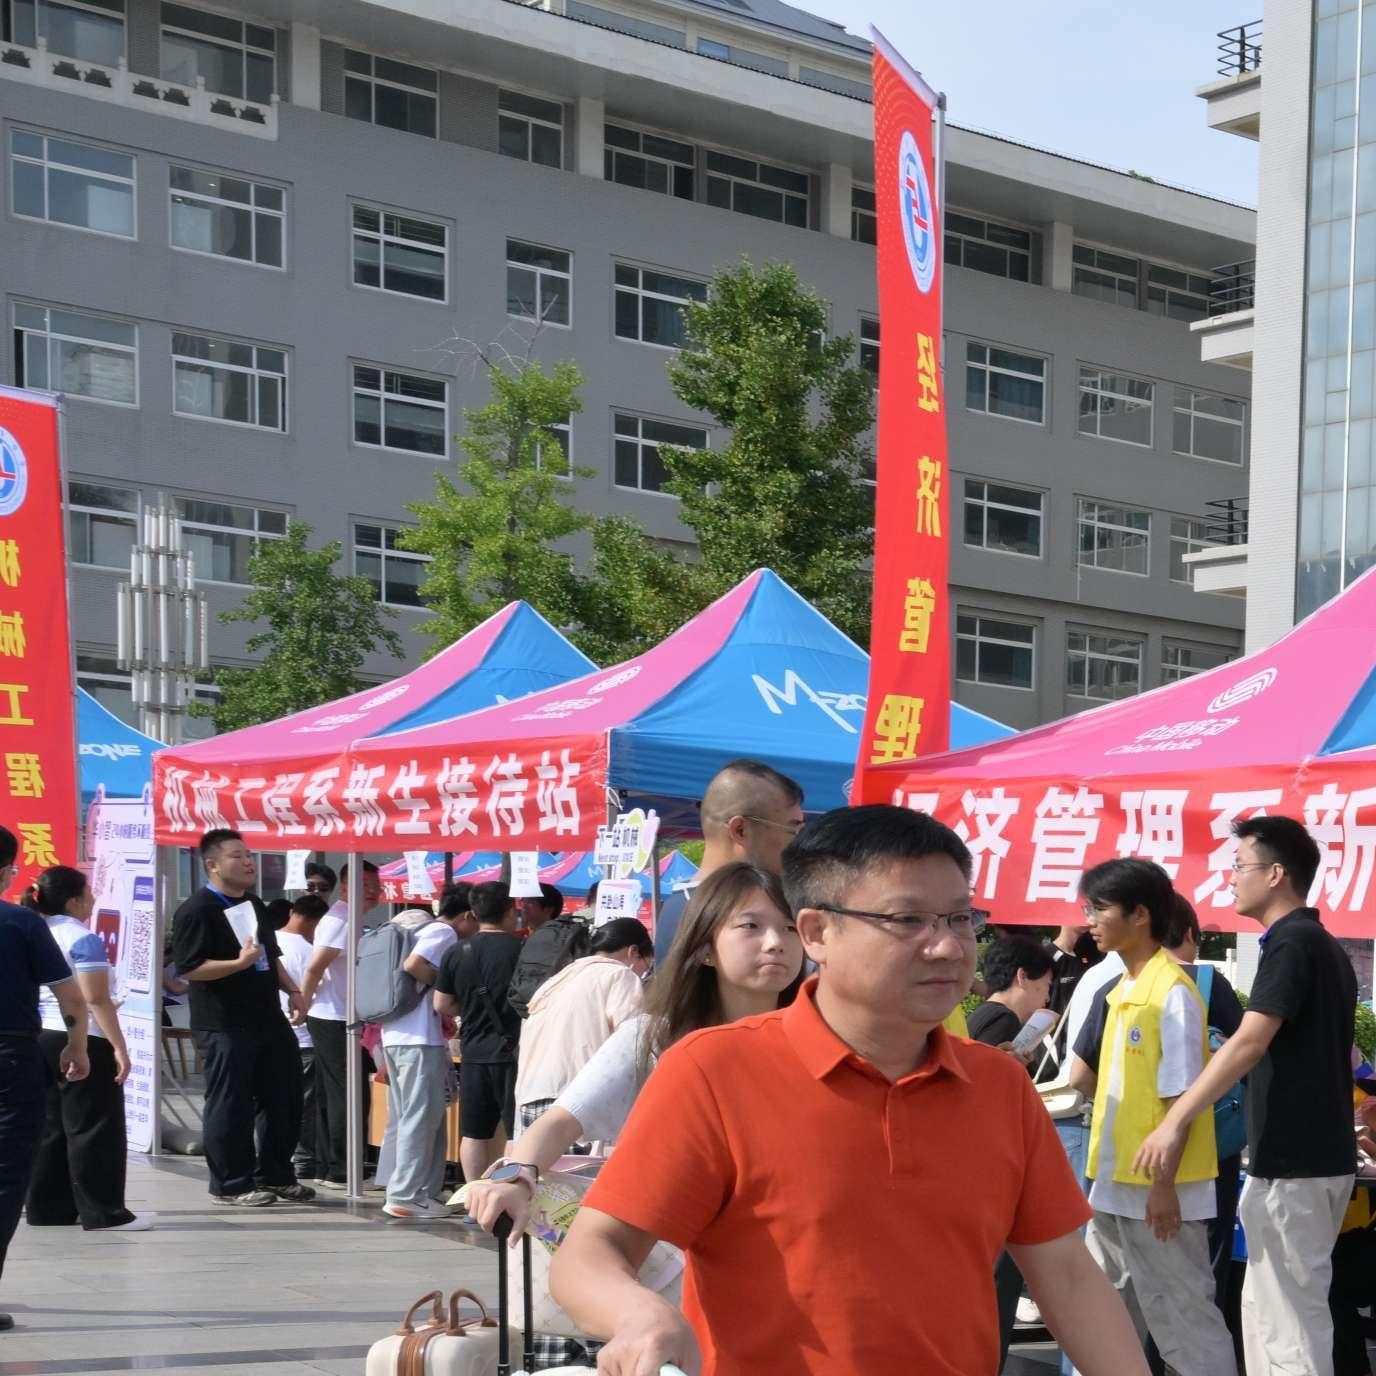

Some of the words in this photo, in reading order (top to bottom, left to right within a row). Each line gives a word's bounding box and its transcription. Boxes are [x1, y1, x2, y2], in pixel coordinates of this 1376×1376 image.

[162, 748, 582, 837] 机械工程系新生接待站
